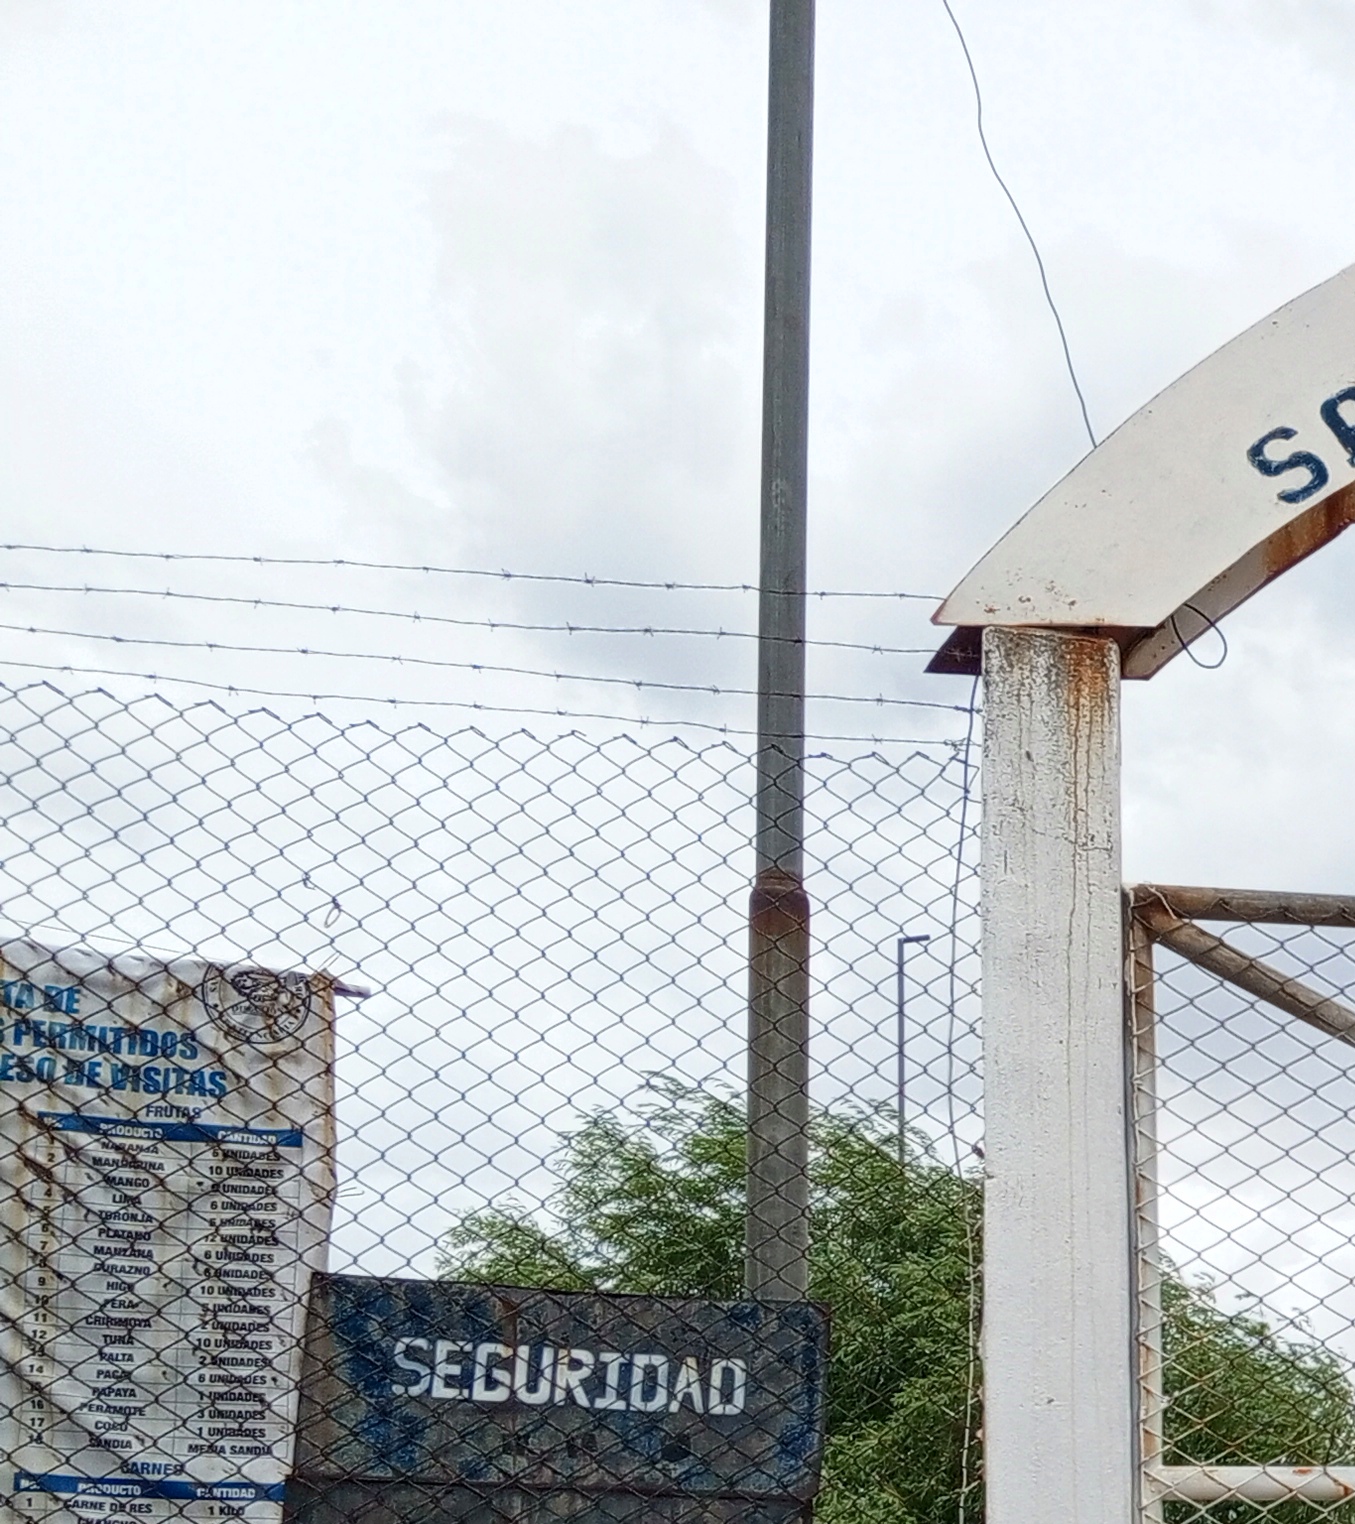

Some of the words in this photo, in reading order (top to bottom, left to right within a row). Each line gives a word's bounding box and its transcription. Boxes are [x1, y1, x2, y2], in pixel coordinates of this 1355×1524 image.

[13, 1018, 198, 1060] PERMITIDOS
[111, 1063, 227, 1098] VISITAS
[146, 1105, 201, 1119] FRUTAS
[209, 1166, 222, 1176] 10
[201, 1286, 214, 1295] 10
[391, 1336, 748, 1416] SEGURIDAD
[92, 1387, 137, 1398] PAPAYA
[129, 1503, 153, 1514] RES
[219, 1505, 244, 1516] KILO
